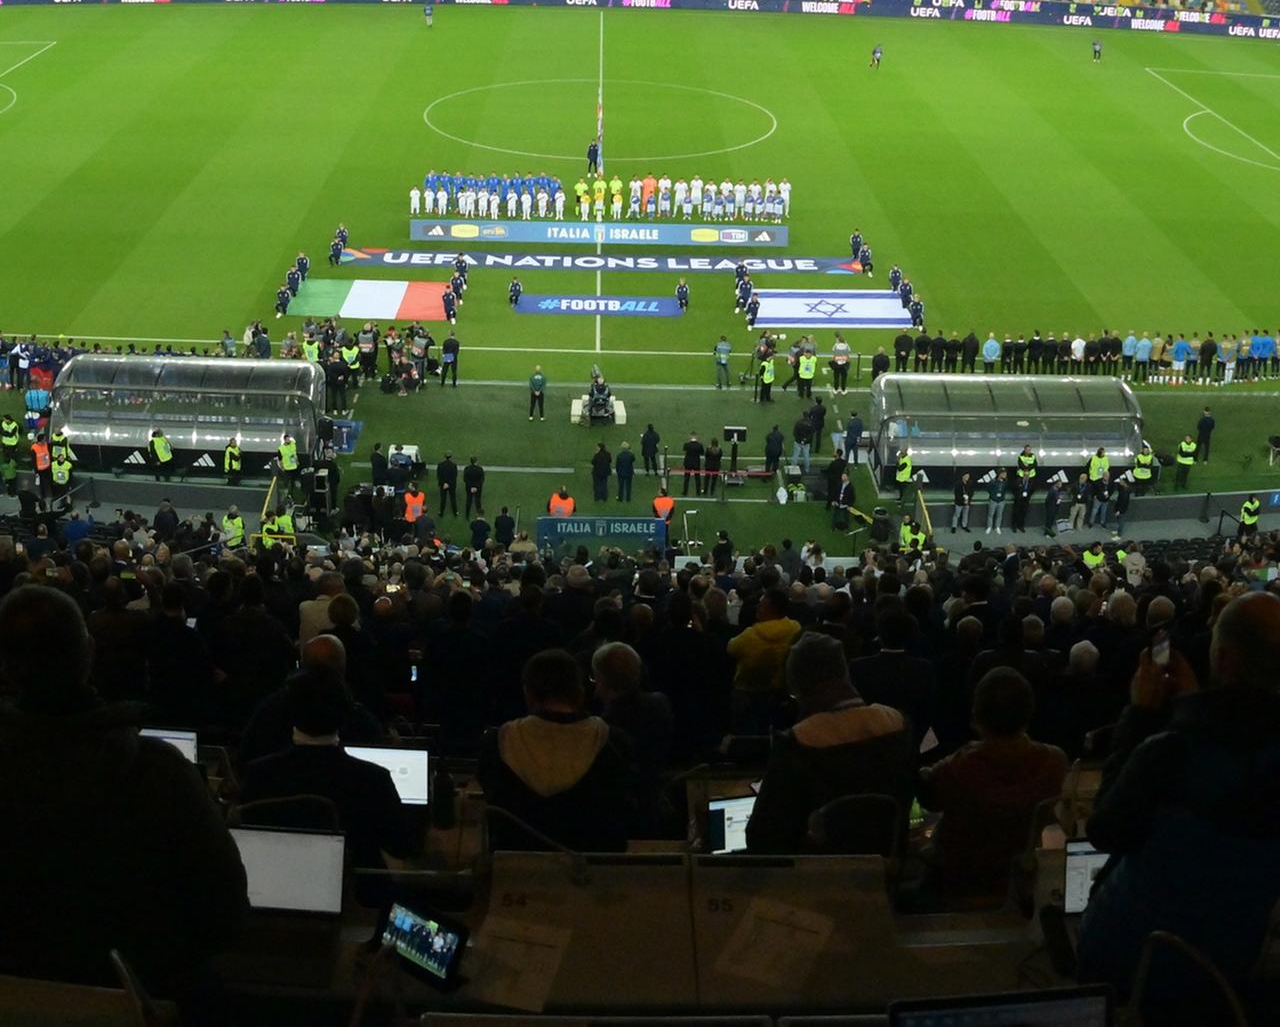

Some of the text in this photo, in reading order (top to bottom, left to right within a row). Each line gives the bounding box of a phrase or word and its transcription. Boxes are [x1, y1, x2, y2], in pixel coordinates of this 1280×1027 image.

[728, 0, 759, 11] UEFA
[802, 1, 856, 15] WELCOME ALL
[910, 6, 941, 18] UEFA
[964, 8, 1011, 23] #FOOTBALL
[1063, 15, 1092, 27] UEFA
[1229, 26, 1256, 38] UEFA
[547, 227, 591, 238] ITALIA
[609, 228, 660, 240] ISRAELE
[383, 252, 819, 271] UEFA NATIONS LEAGUE
[537, 298, 662, 312] #FOOTBALL
[557, 523, 591, 534] ITALIA
[610, 523, 656, 534] ISRAELE
